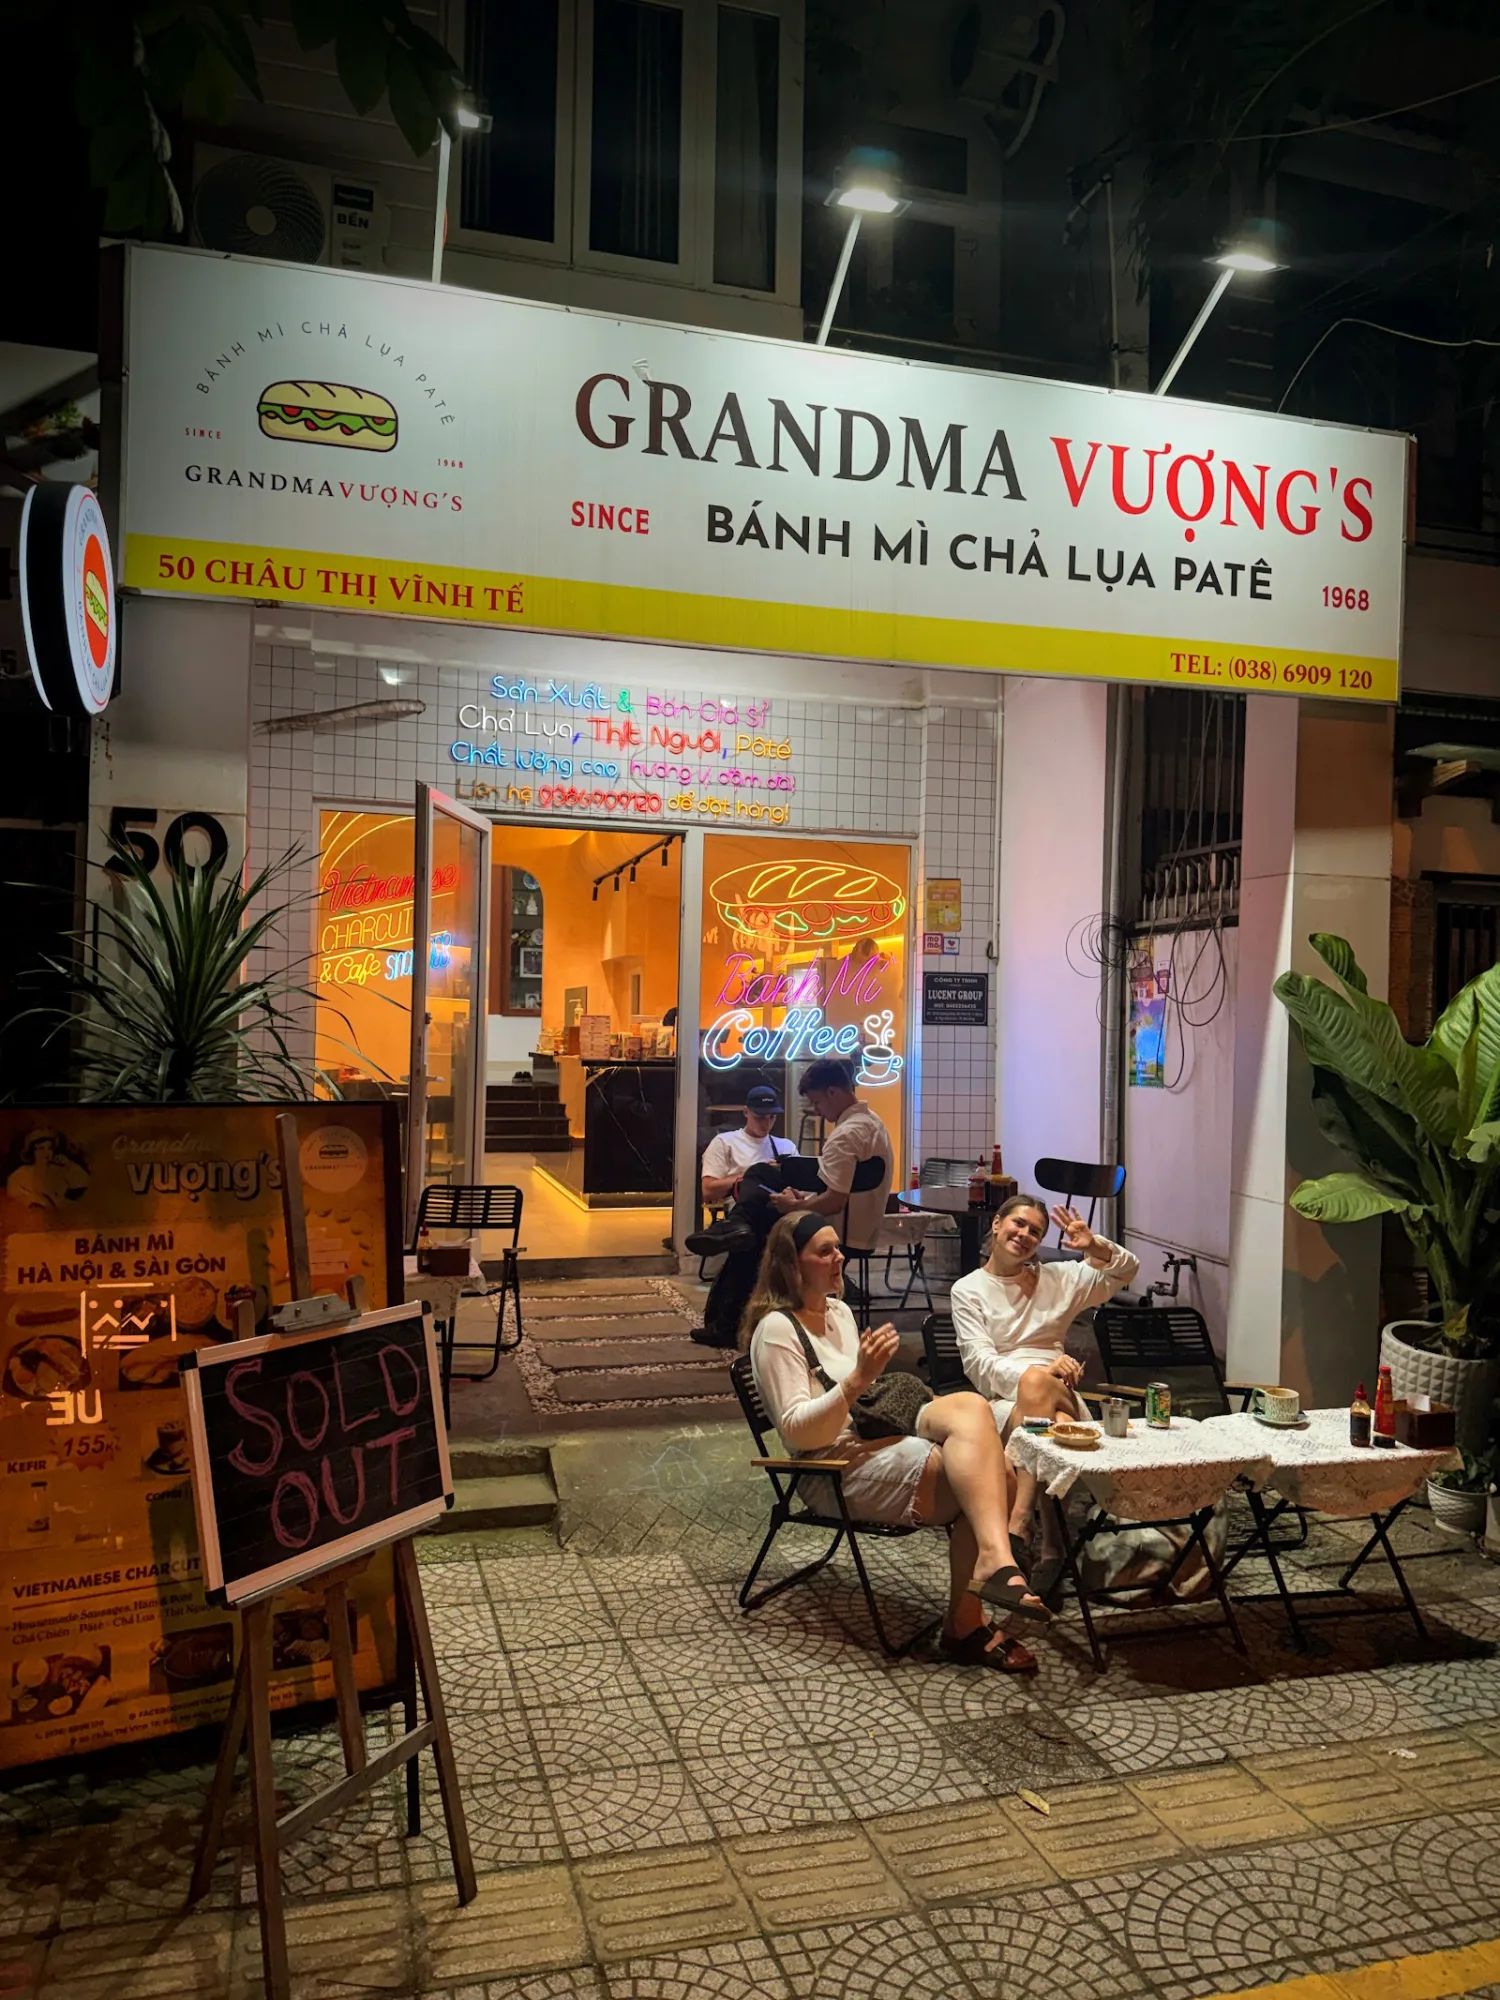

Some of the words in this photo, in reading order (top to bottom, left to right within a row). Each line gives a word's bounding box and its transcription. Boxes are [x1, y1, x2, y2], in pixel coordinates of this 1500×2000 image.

[196, 341, 245, 394] BÁNH
[258, 322, 284, 342] MÌ
[302, 320, 348, 339] CHẢ
[365, 335, 405, 367] LỤA
[415, 374, 455, 425] PATÊ
[185, 427, 222, 440] SINCE
[437, 458, 464, 469] 1968
[575, 373, 1027, 501] GRANDMA
[1050, 436, 1373, 543] VƯỢNG'S
[571, 500, 650, 535] SINCE
[706, 500, 850, 558] BÁNH
[873, 519, 928, 566] MÌ
[949, 527, 1048, 579] CHẢ
[1068, 545, 1156, 592] LỤA
[1174, 557, 1272, 601] PATÊ
[1322, 585, 1370, 612] 1968
[158, 554, 195, 580] 50
[205, 558, 306, 591] CHÂU
[316, 569, 377, 606] THỊ
[388, 574, 474, 610] VĨNH
[484, 582, 524, 614] TẾ
[1170, 652, 1223, 676] TEL:
[1228, 658, 1277, 684] (038)
[1283, 663, 1331, 686] 6909
[1338, 668, 1373, 690] 120
[491, 675, 538, 703] Sản
[549, 679, 611, 710] Xuất
[617, 688, 632, 712] &
[459, 704, 515, 734] Chả
[450, 741, 508, 767] Chất
[507, 782, 533, 806] hệ
[104, 806, 228, 879] 50
[320, 962, 332, 984] &
[334, 953, 381, 986] Cafe
[715, 948, 824, 1007] Bánh
[824, 951, 898, 1006] Mì
[928, 989, 956, 1000] LUCENT
[957, 990, 983, 1000] GROUP
[702, 1008, 860, 1070] Coffee
[75, 1234, 140, 1256] BÁNH
[147, 1231, 174, 1252] MÌ
[18, 1263, 52, 1285] HÀ
[60, 1261, 103, 1284] NỘI
[109, 1263, 127, 1280] &
[134, 1257, 170, 1278] SÀI
[176, 1253, 227, 1275] GÒN
[225, 1344, 421, 1476] SOLD
[7, 1459, 48, 1475] KEFIR
[271, 1426, 416, 1549] OUT
[12, 1570, 121, 1599] VIETNAMESE
